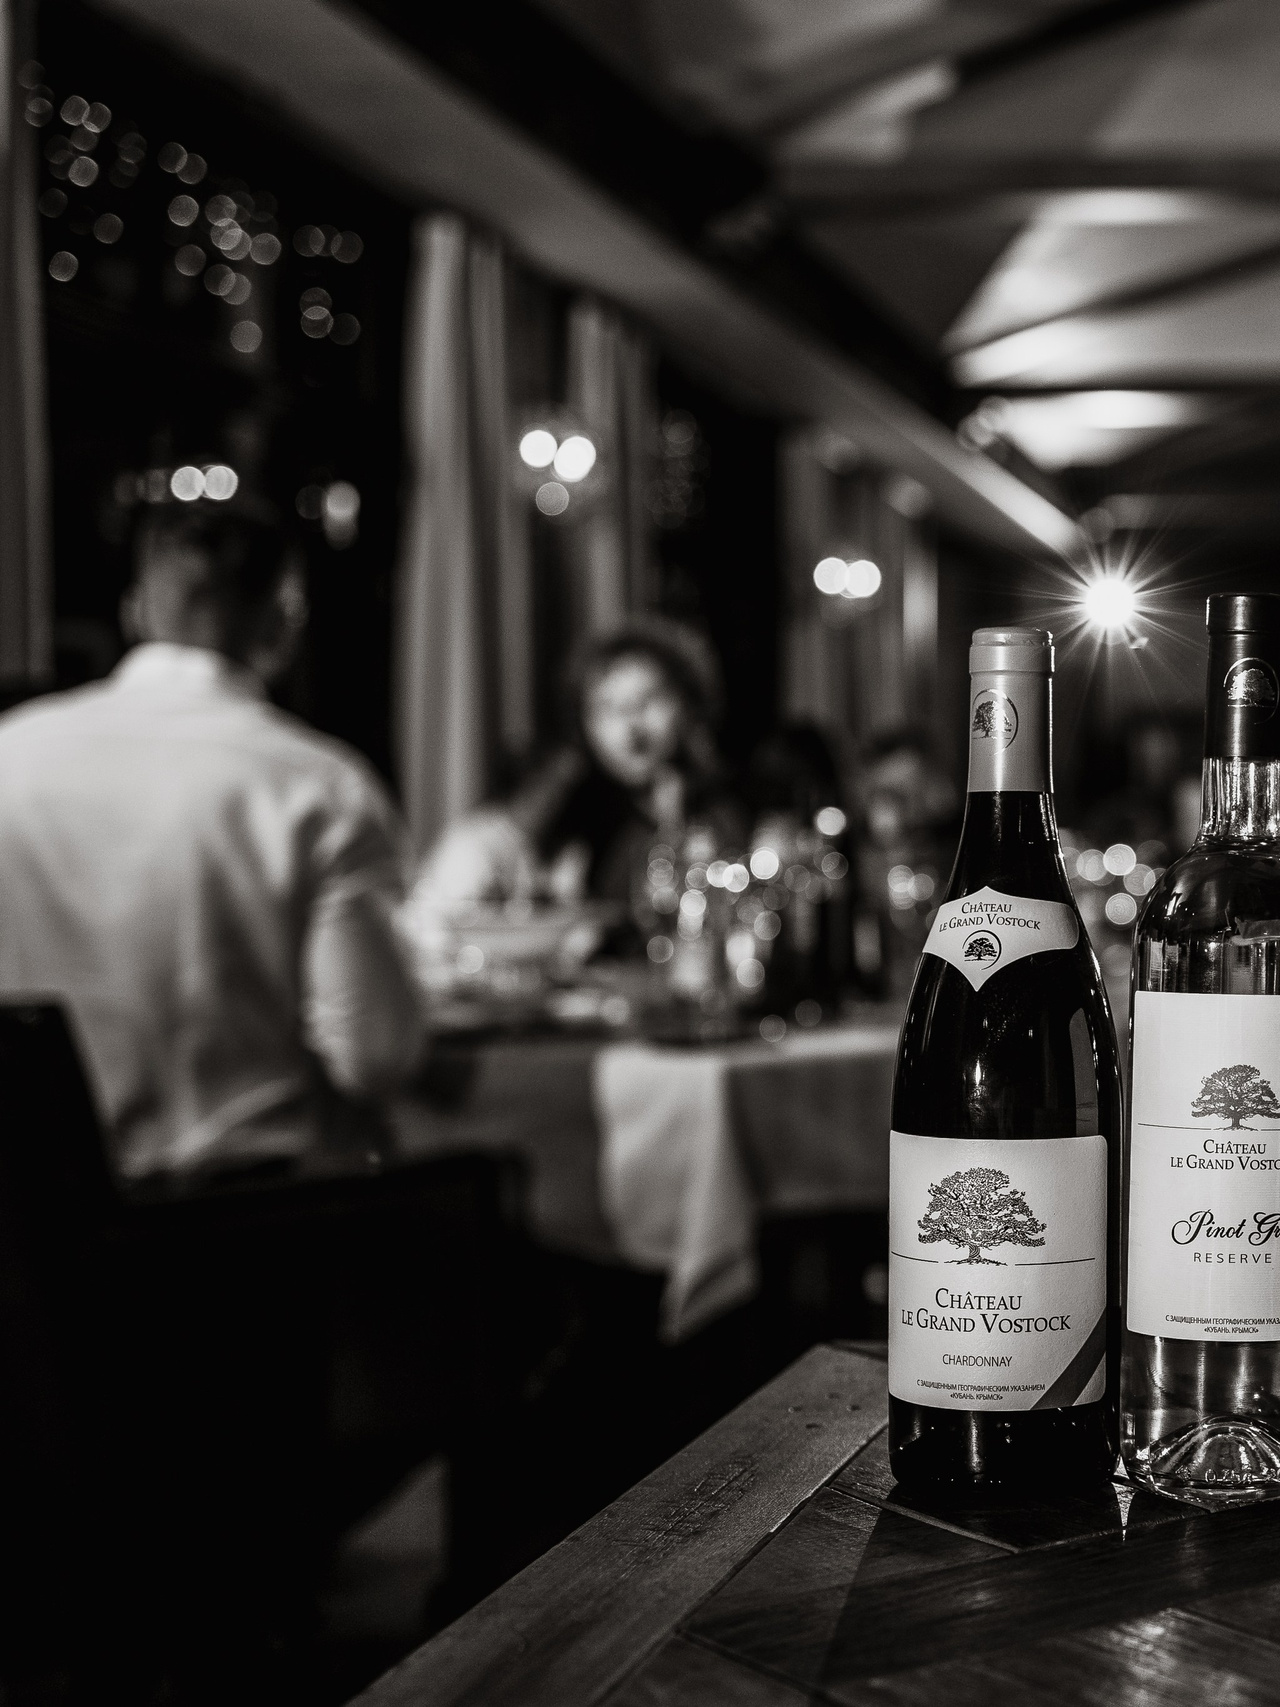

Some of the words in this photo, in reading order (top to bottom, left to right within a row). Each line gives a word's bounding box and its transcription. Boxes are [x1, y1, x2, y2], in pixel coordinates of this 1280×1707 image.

[961, 902, 1012, 914] CHÂTEAU
[939, 922, 948, 932] LE
[948, 916, 984, 929] GRAND
[986, 914, 1041, 930] VOSTOCK
[1203, 1139, 1267, 1154] CHÂTEAU
[1170, 1156, 1184, 1168] LE
[1186, 1154, 1234, 1170] GRAND
[1172, 1208, 1246, 1245] Pinot
[1193, 1252, 1272, 1264] RESERVE
[935, 1287, 1022, 1310] CHÂTEAU
[901, 1309, 914, 1326] LE
[916, 1308, 975, 1333] GRAND
[980, 1313, 1071, 1334] VOSTOCK
[942, 1354, 1012, 1367] CHARDONNAY
[1010, 1384, 1046, 1392] УКАЗАНИЕМ
